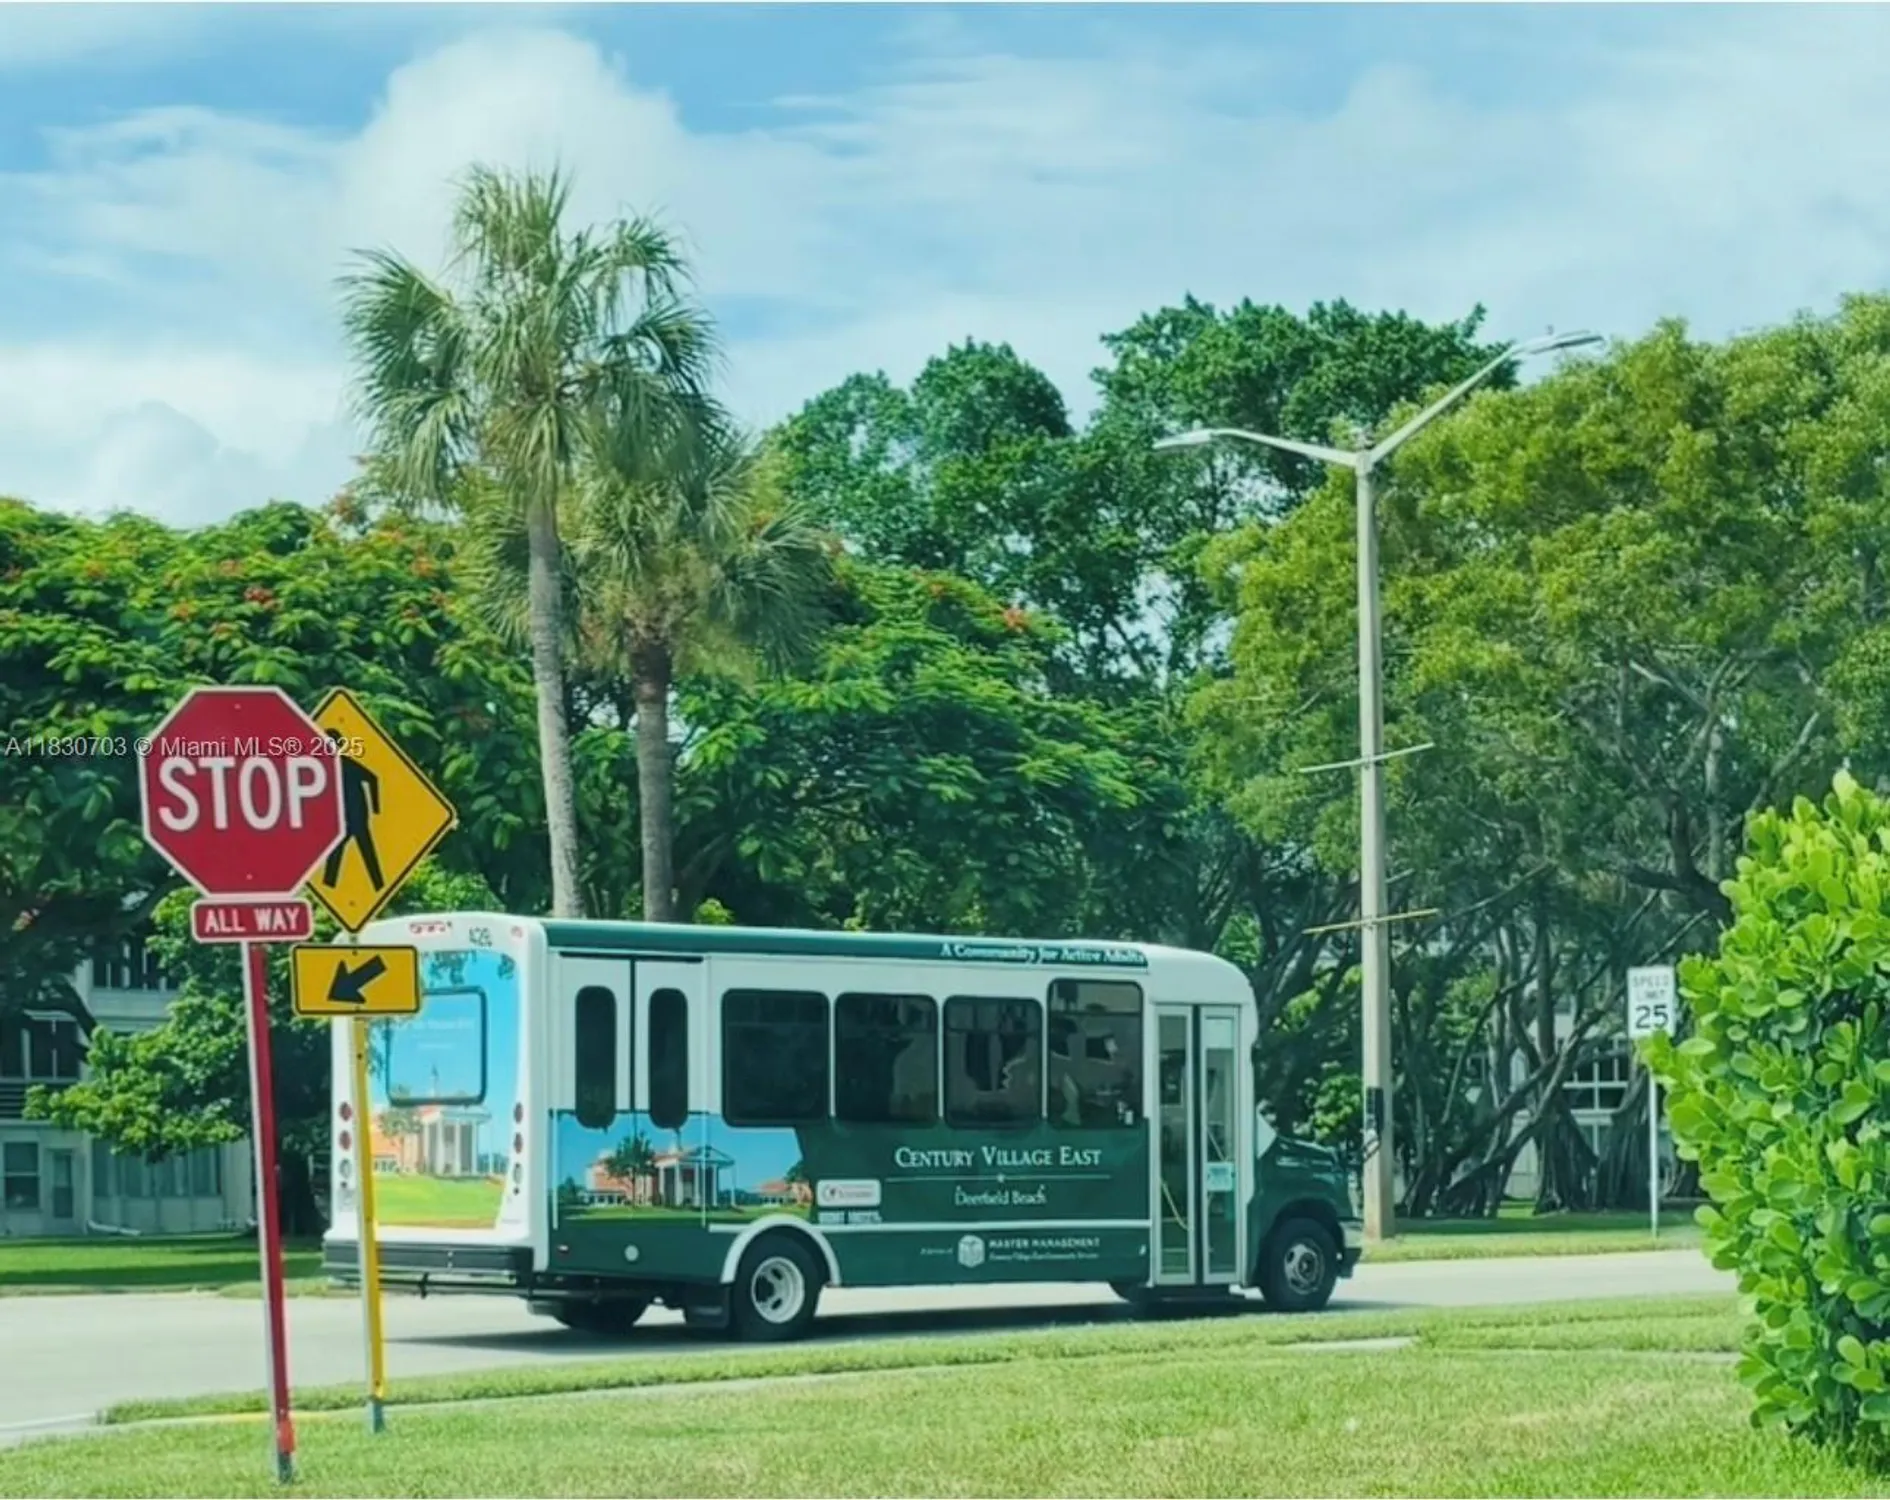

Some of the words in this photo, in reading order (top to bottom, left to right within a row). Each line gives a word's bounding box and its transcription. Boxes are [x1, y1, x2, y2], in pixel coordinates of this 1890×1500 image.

[158, 756, 328, 831] STOP
[204, 910, 246, 933] ALL
[254, 907, 301, 932] WAY
[1635, 1004, 1669, 1029] 25
